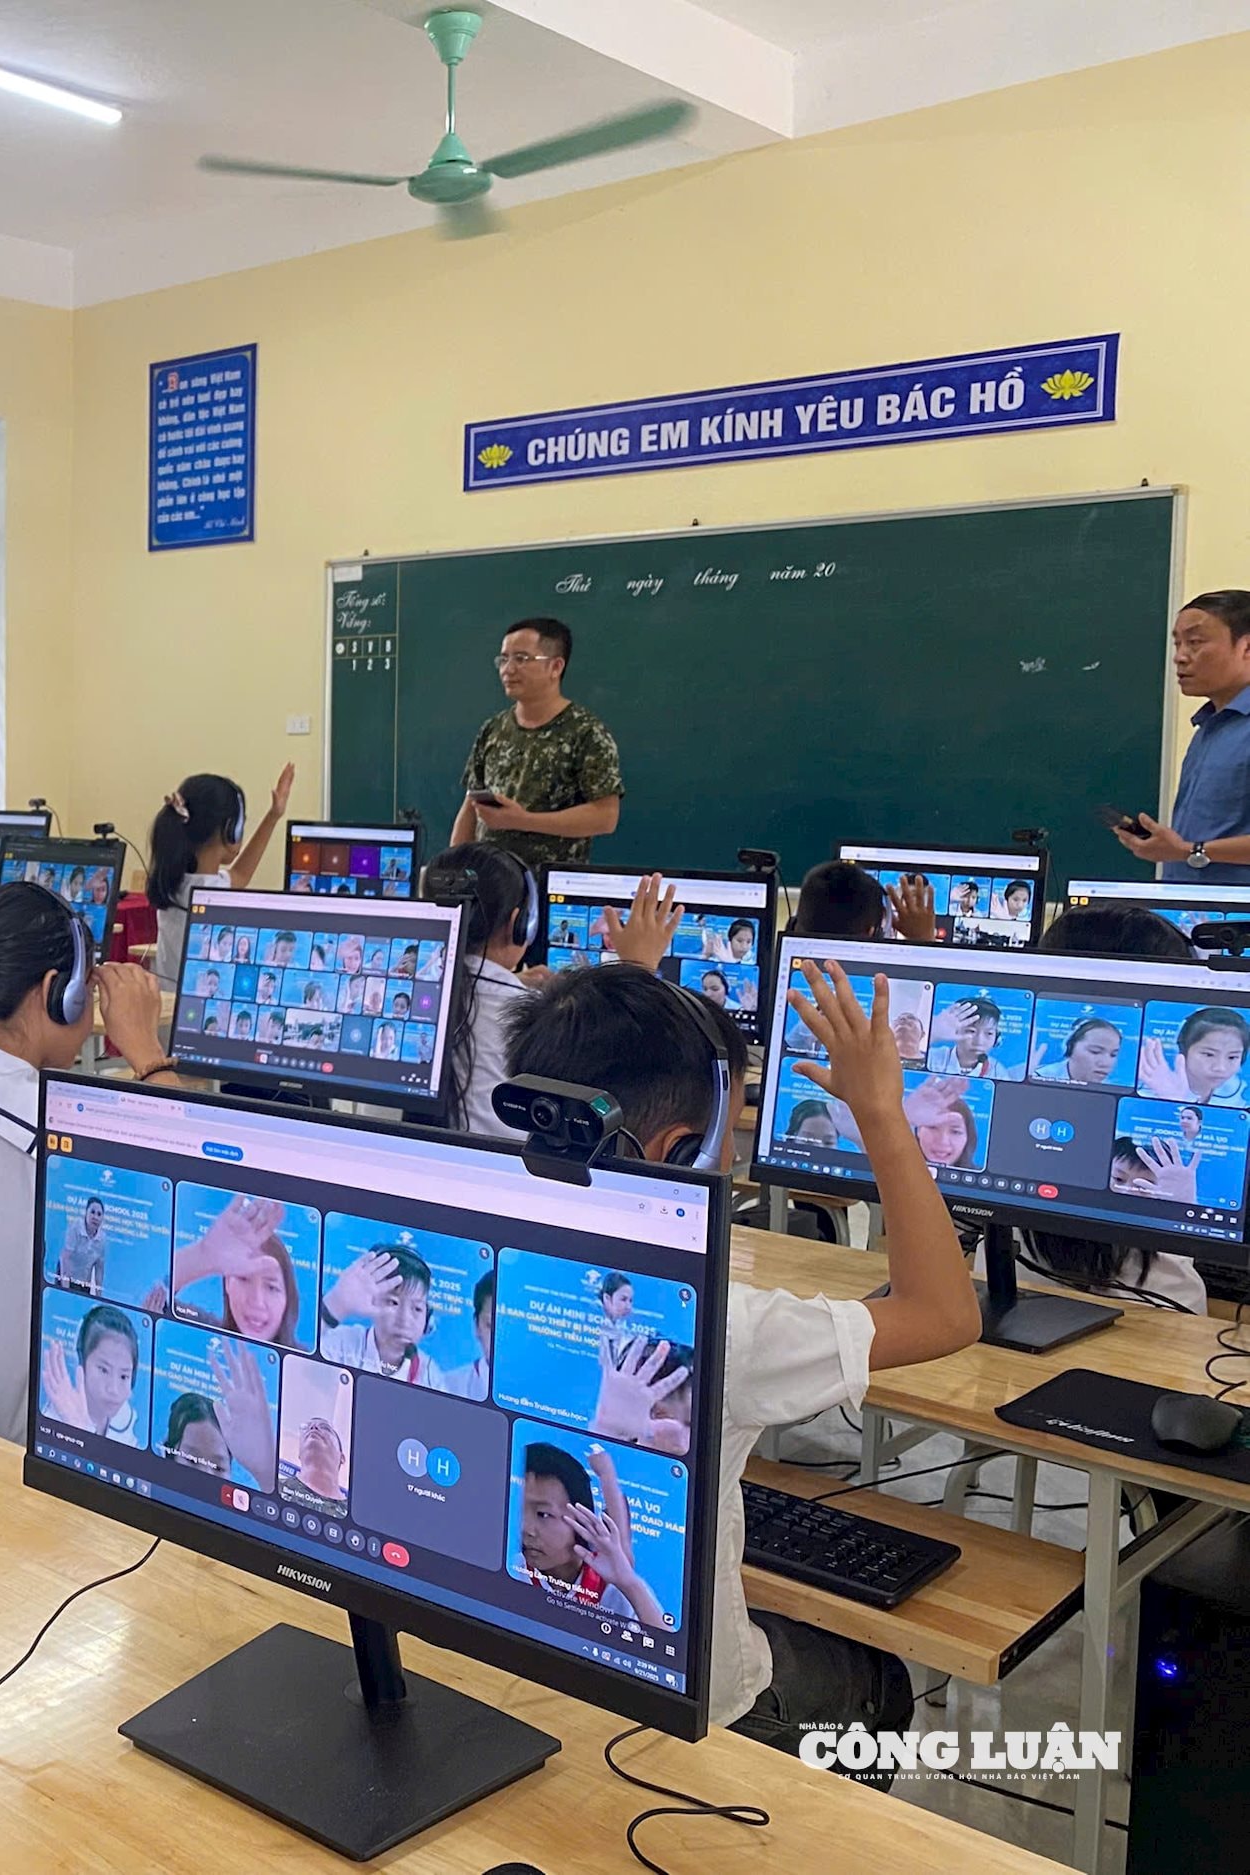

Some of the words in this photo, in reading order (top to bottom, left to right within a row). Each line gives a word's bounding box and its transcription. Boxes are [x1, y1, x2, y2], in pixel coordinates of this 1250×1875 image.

[526, 424, 631, 467] CHÚNG
[640, 419, 690, 454] EM
[699, 405, 783, 447] KÍNH
[795, 395, 865, 435] YÊU
[876, 381, 956, 427] BÁC
[969, 366, 1026, 414] HỒ
[626, 573, 665, 597] ngày
[693, 566, 740, 592] tháng
[770, 564, 808, 581] năm
[812, 561, 838, 578] 20
[1036, 1124, 1046, 1135] H
[1057, 1127, 1067, 1137] H
[951, 1204, 994, 1218] HIKVISION
[438, 1278, 462, 1292] 2025
[526, 1311, 547, 1324] GIAO
[529, 1299, 545, 1313] DỰ
[546, 1302, 562, 1315] ÁN
[562, 1306, 586, 1323] MINI
[630, 1321, 657, 1338] 2025
[407, 1448, 420, 1468] H
[436, 1457, 450, 1478] H
[276, 1564, 332, 1593] HIKVISION
[533, 1569, 548, 1583] Lâm
[548, 1574, 572, 1591] Trường
[571, 1582, 585, 1595] tiểu
[585, 1587, 599, 1600] học
[546, 1595, 556, 1606] Go
[556, 1599, 563, 1608] to
[563, 1602, 587, 1617] Settings
[587, 1610, 595, 1619] to
[595, 1613, 620, 1628] activate
[548, 1586, 578, 1603] Activate
[578, 1595, 615, 1616] Windows
